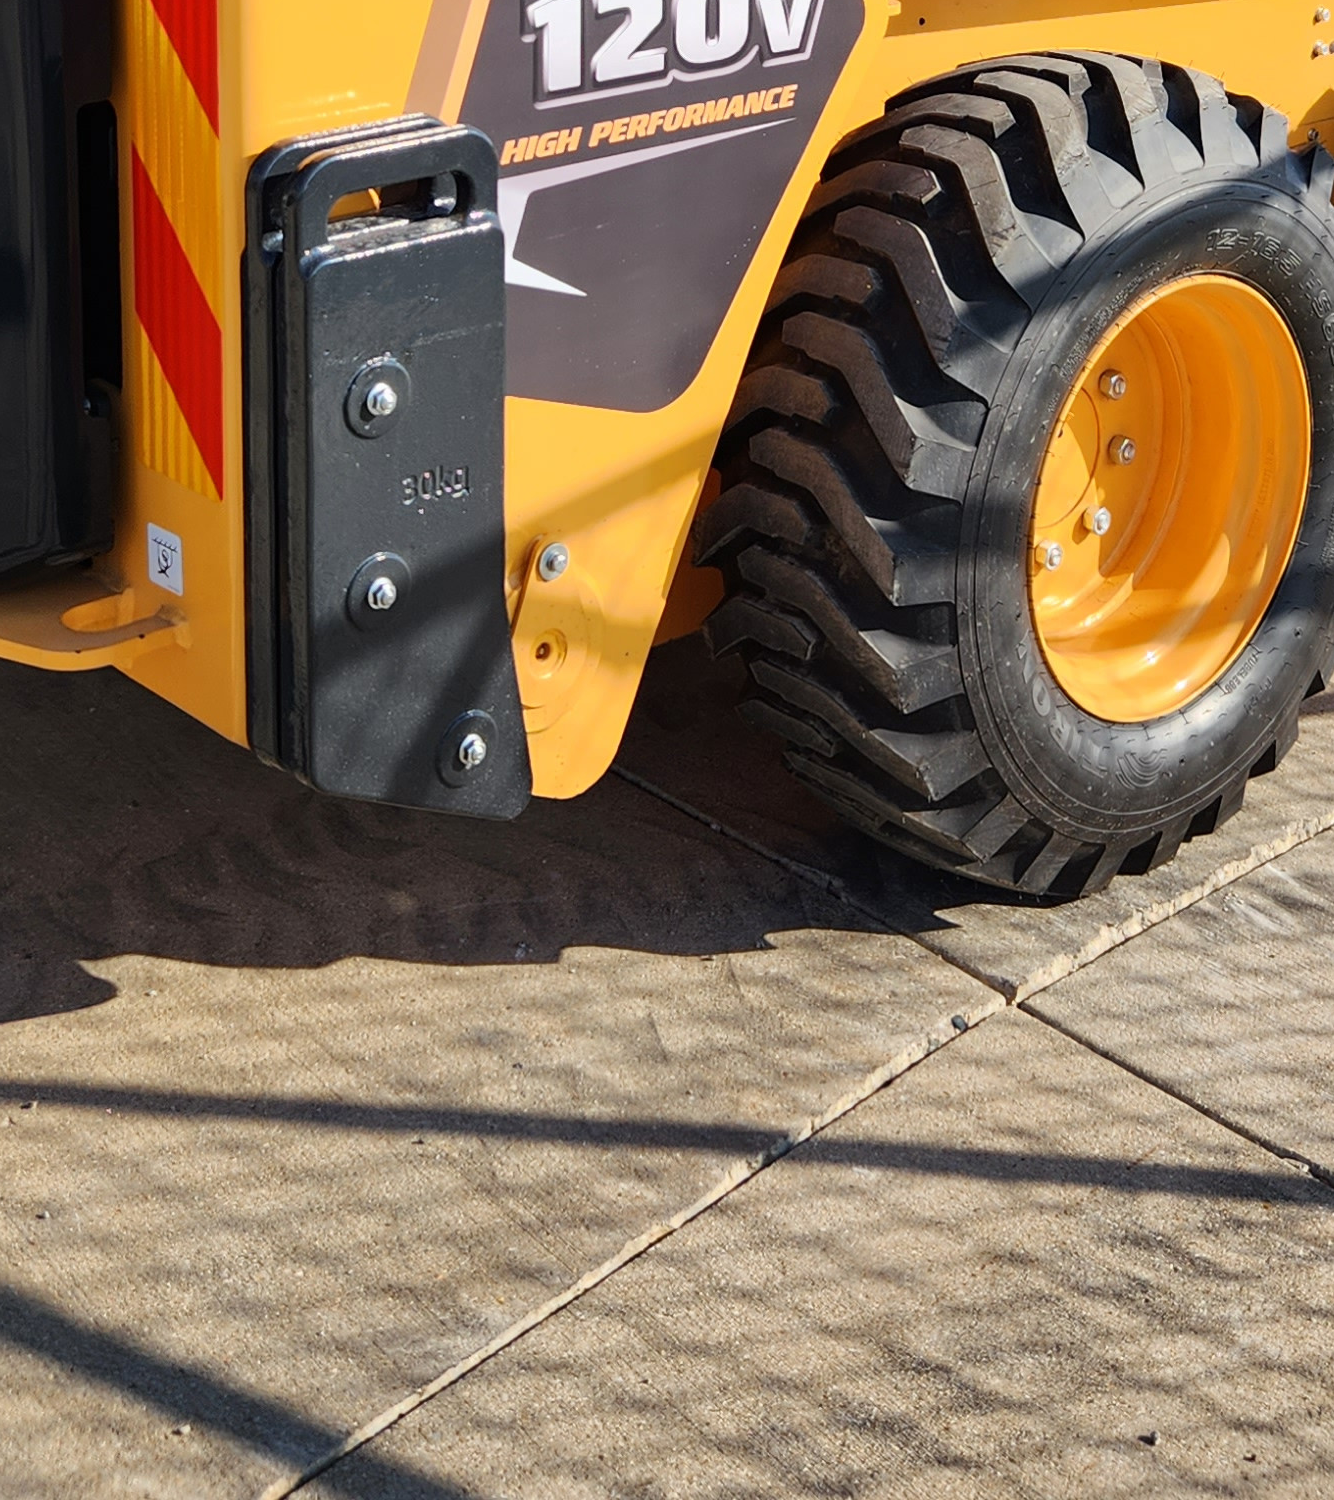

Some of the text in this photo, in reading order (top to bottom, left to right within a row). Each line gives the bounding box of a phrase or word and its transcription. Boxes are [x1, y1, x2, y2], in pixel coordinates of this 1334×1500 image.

[500, 84, 798, 166] HIGH PERFORMANCE
[402, 465, 470, 505] 30kg
